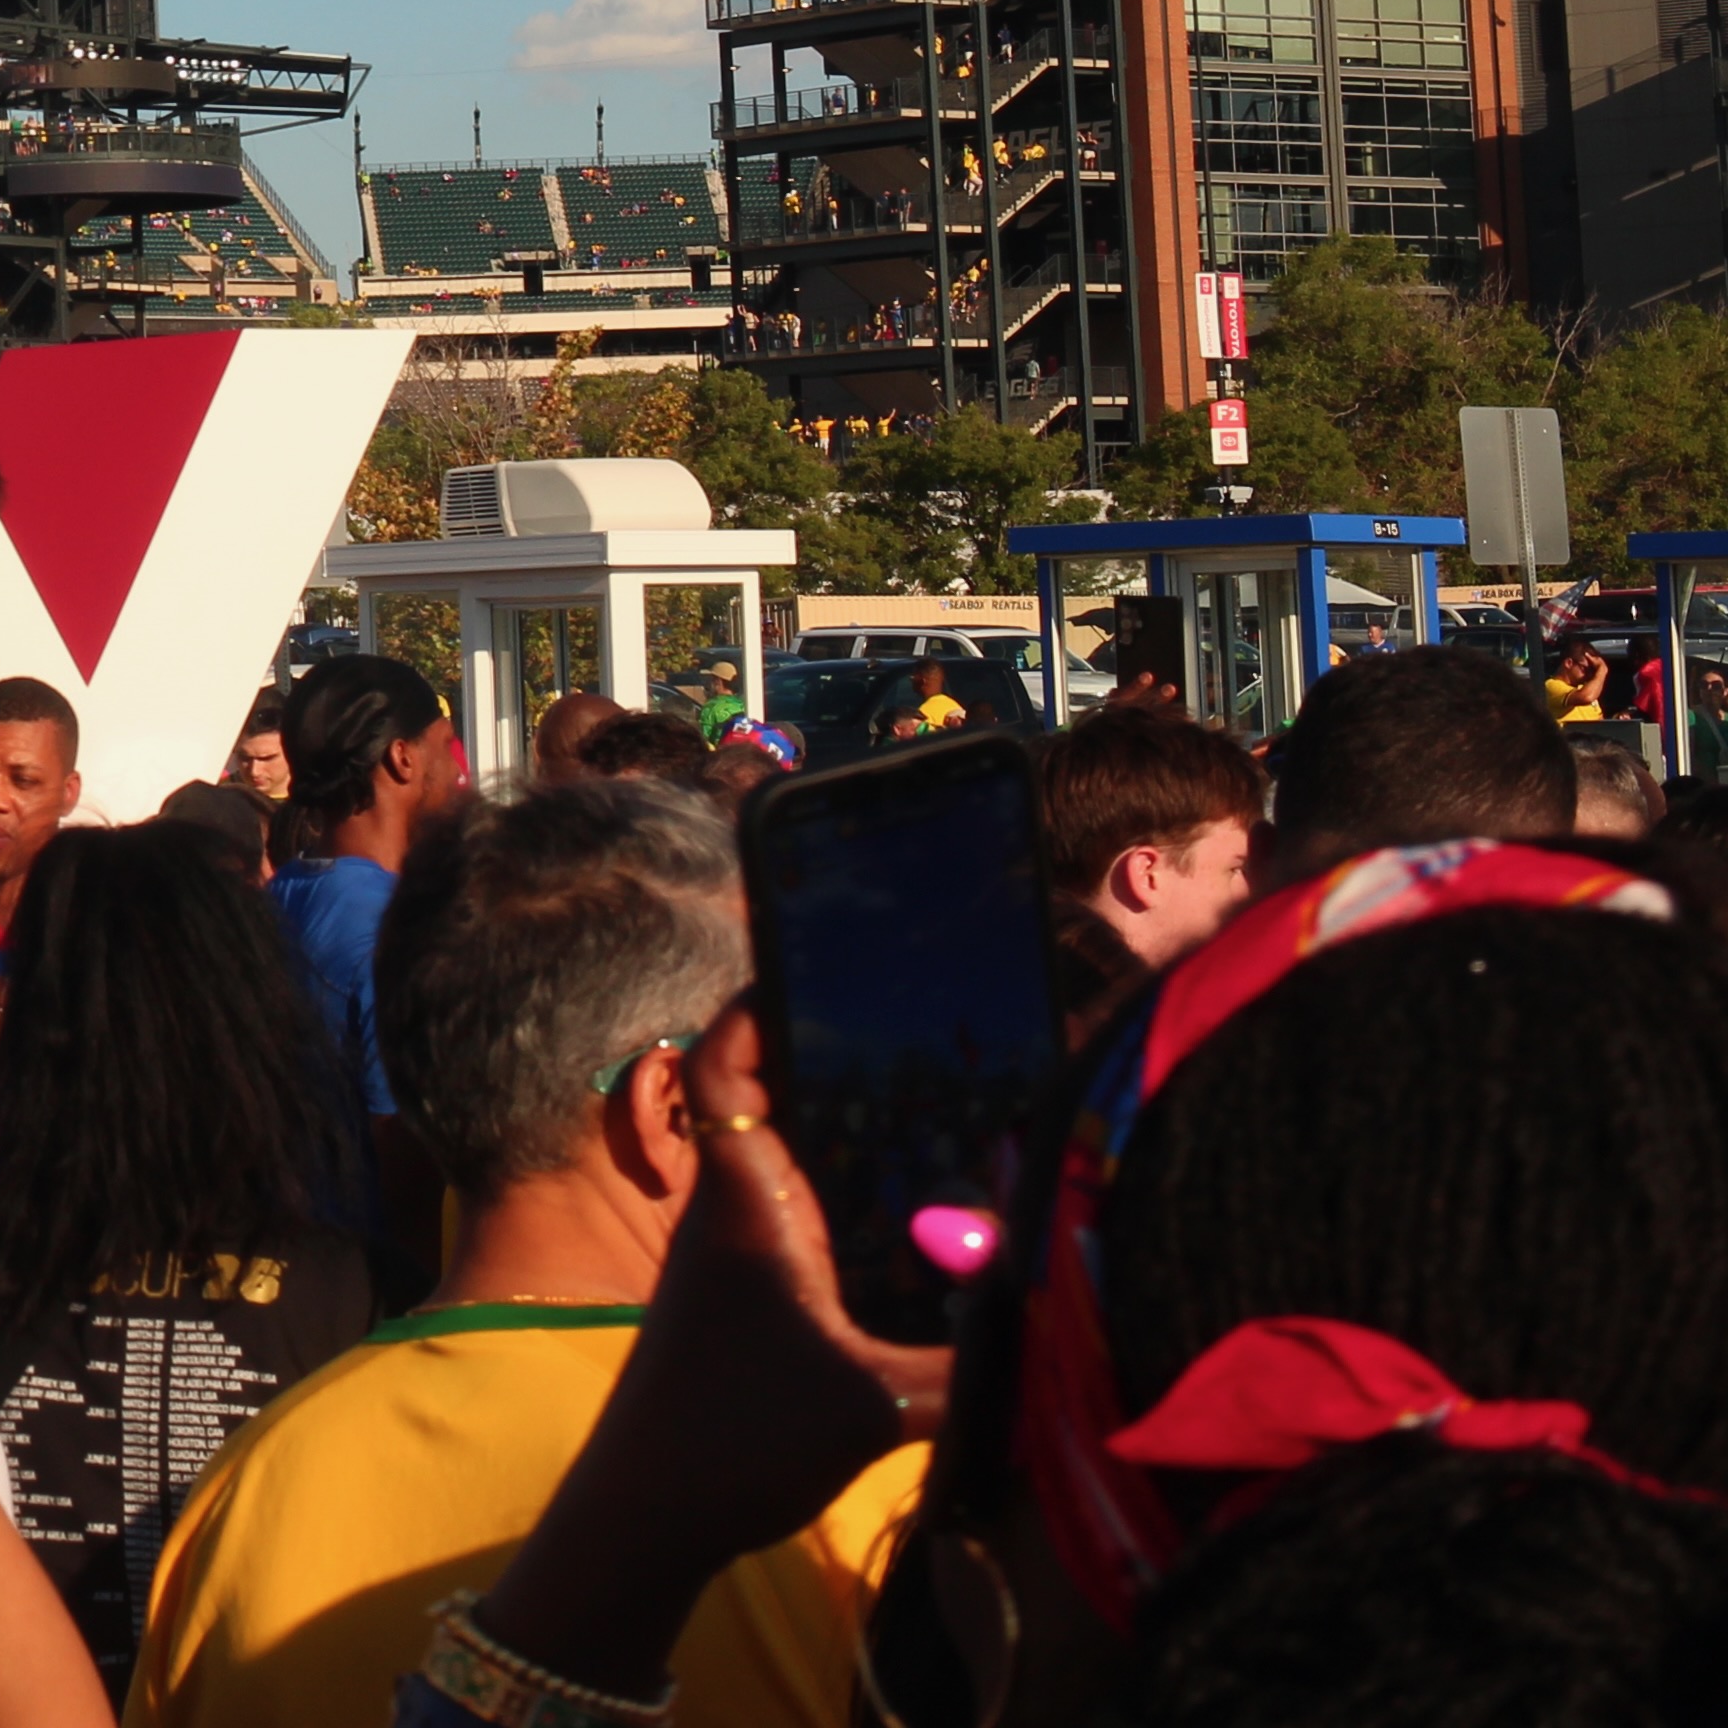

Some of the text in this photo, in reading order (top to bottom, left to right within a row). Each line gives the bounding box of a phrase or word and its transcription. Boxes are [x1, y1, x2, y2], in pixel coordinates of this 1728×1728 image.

[1228, 301, 1241, 358] TOYOTA
[1217, 405, 1239, 421] F2
[992, 600, 1033, 610] RENTALS
